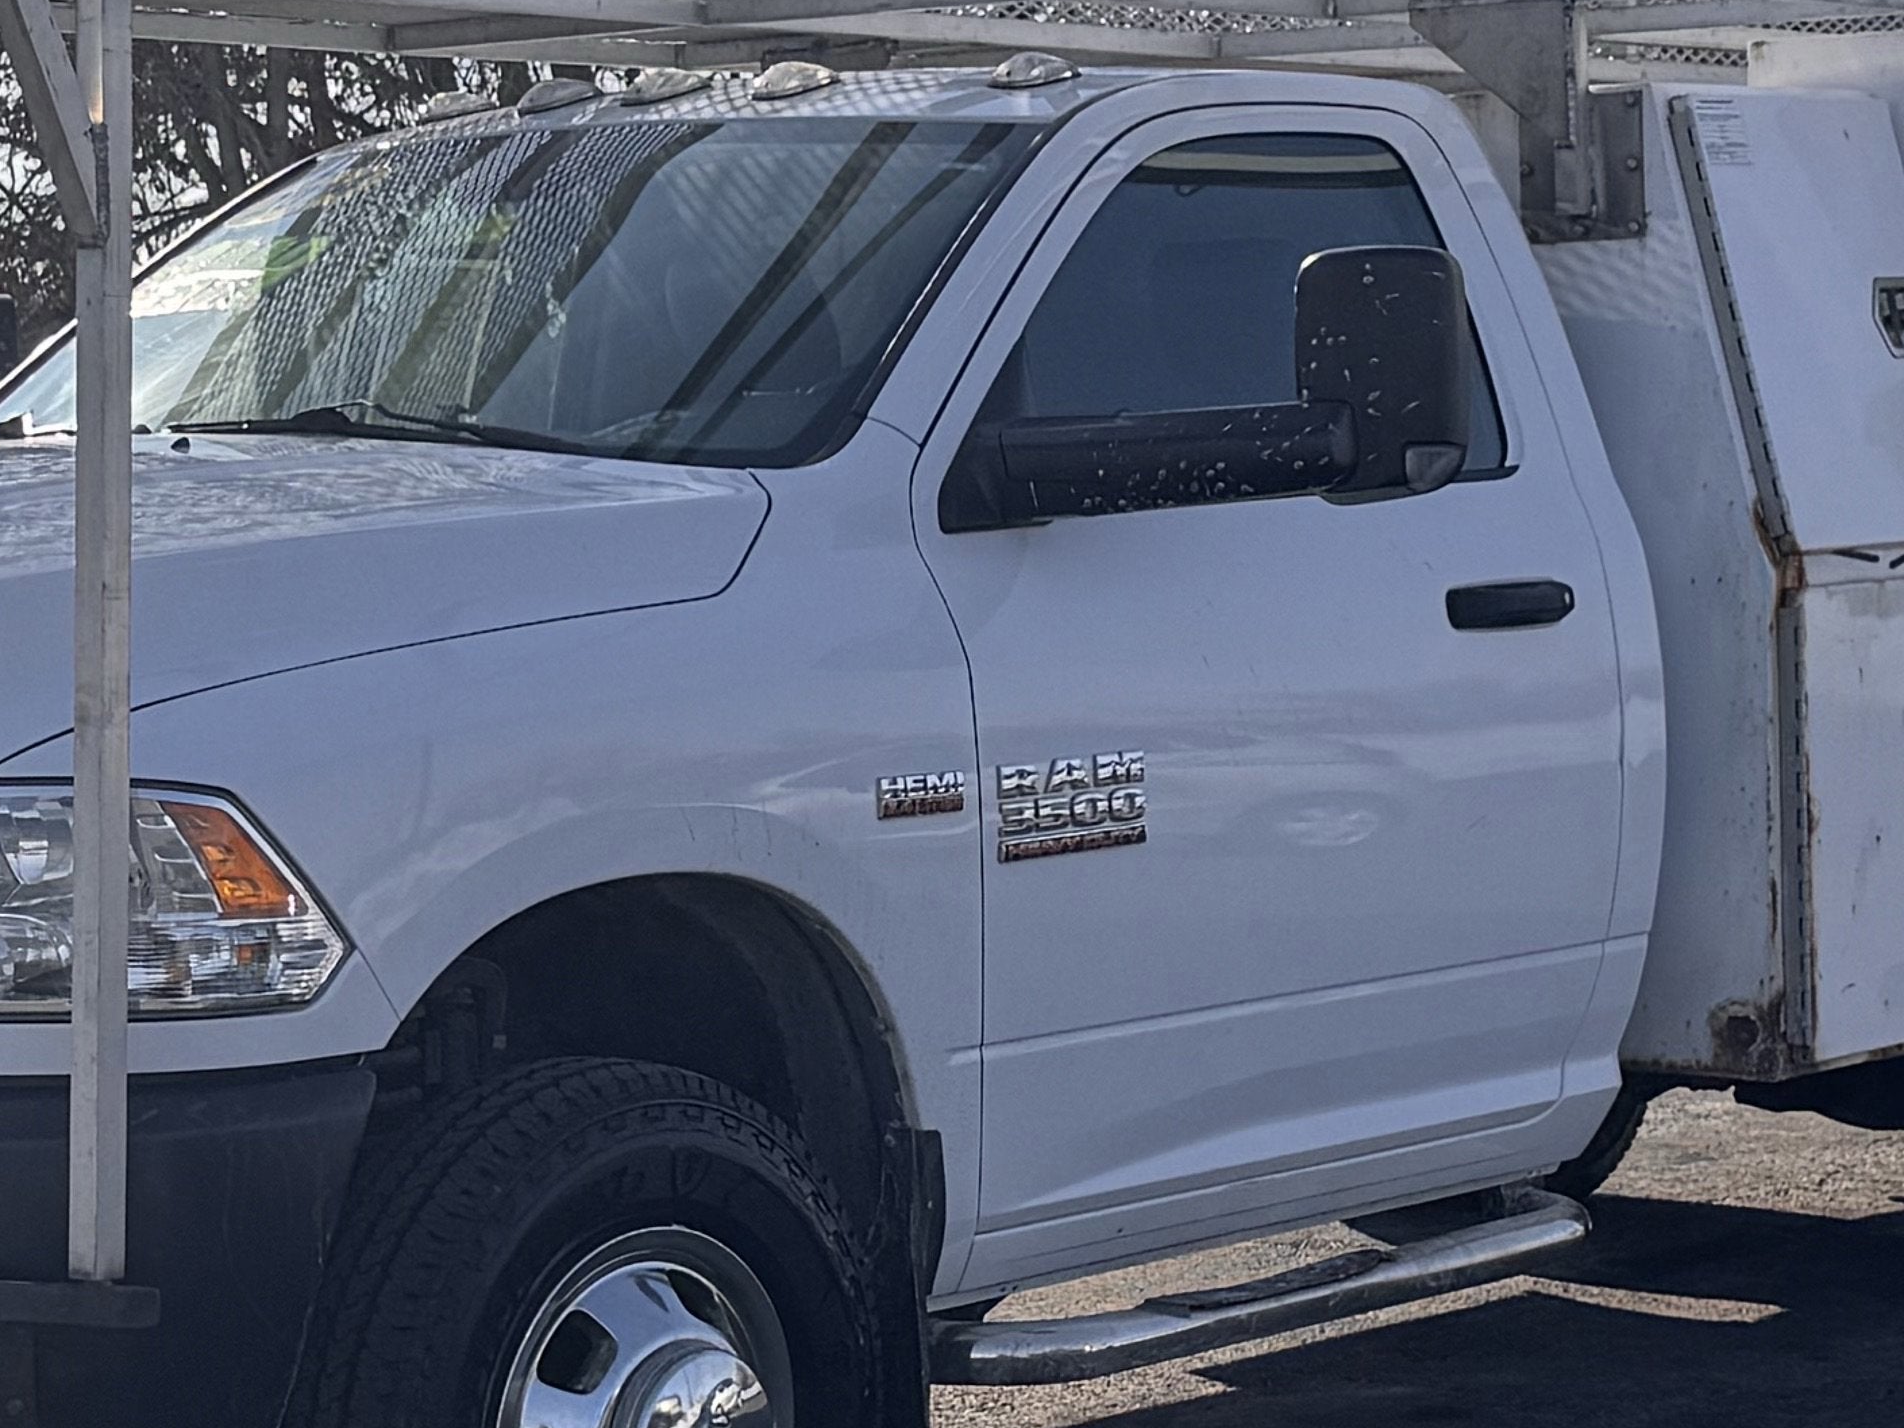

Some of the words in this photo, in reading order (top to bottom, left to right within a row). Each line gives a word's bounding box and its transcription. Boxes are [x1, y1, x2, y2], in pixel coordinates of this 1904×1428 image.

[880, 771, 965, 799] HEMI
[997, 750, 1145, 799] RAM
[998, 786, 1147, 838] 3500
